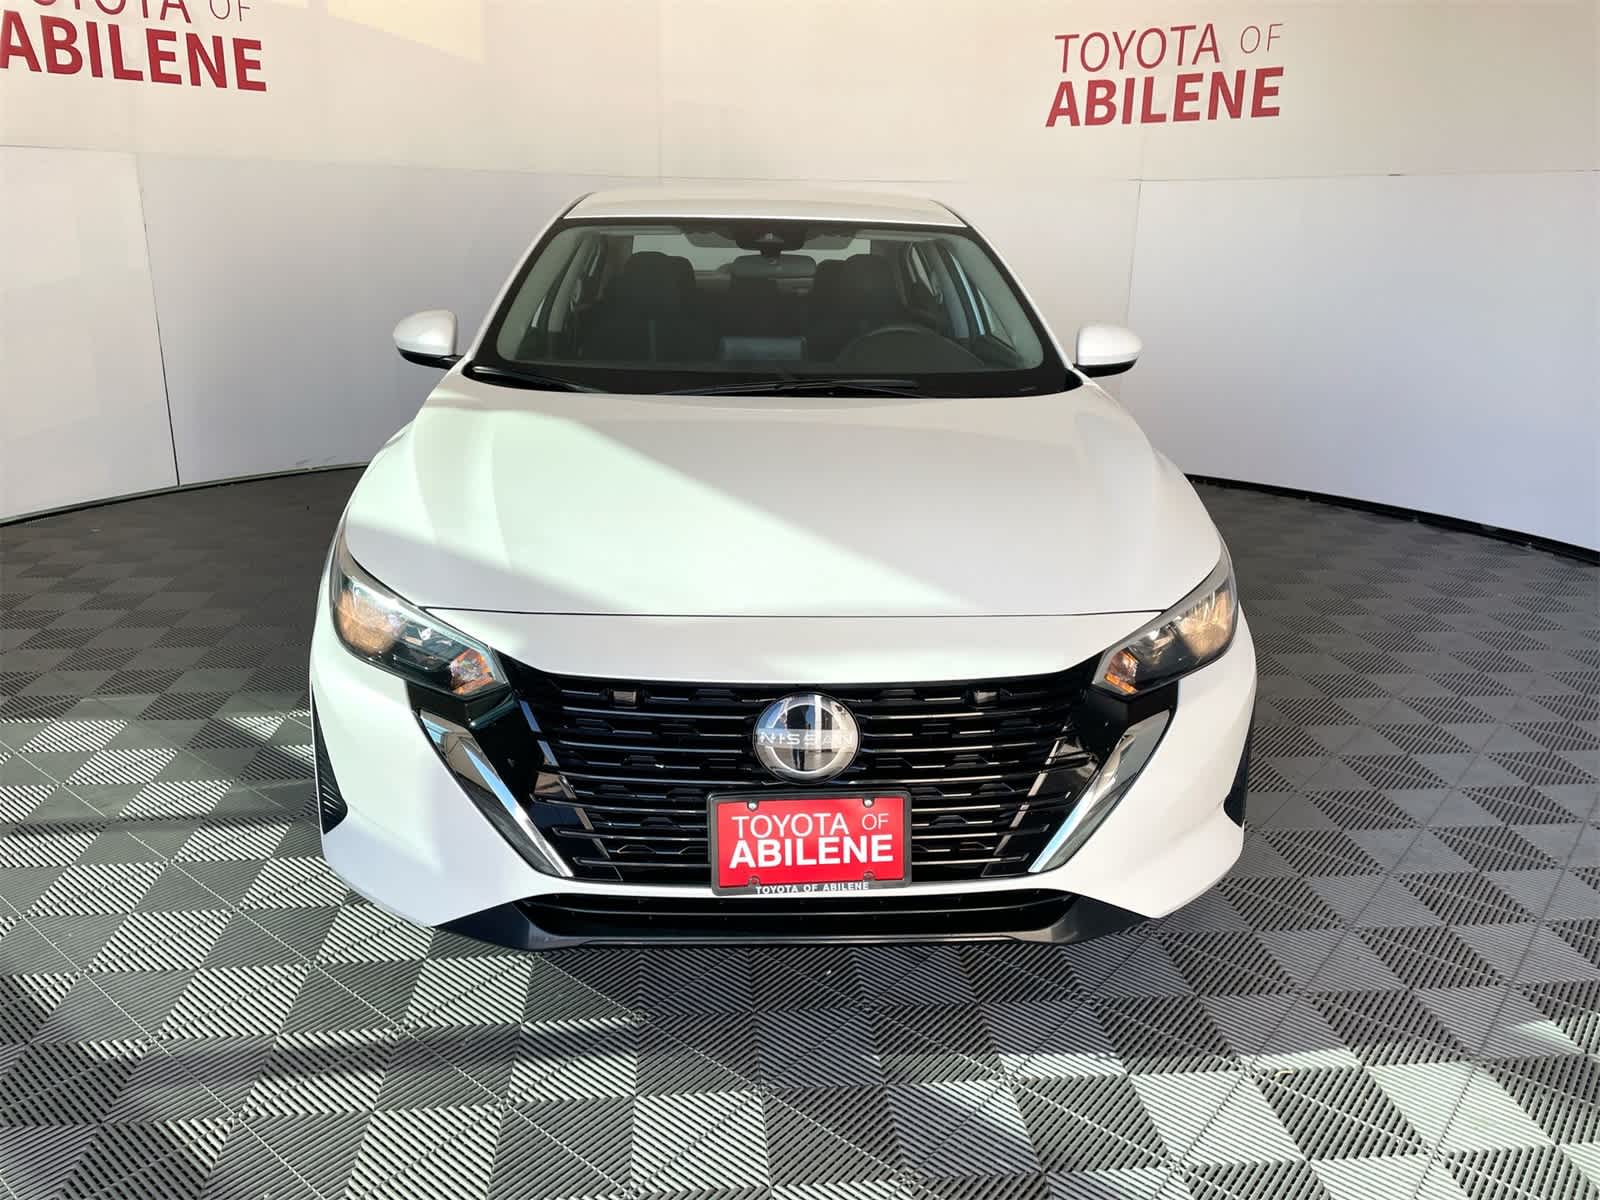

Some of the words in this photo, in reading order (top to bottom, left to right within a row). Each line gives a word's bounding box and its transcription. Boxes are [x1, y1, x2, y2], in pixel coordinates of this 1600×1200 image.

[0, 10, 267, 92] ABILENE
[1054, 23, 1220, 73] TOYOTA
[1240, 23, 1284, 54] OF
[1045, 67, 1284, 128] ABILENE
[759, 732, 853, 746] NISSAN
[731, 813, 849, 838] TOYOTA
[861, 813, 889, 831] OF
[729, 834, 894, 869] ABILENE
[756, 885, 800, 895] TOYOTA
[803, 883, 819, 892] OF
[823, 881, 870, 891] ABILENE
